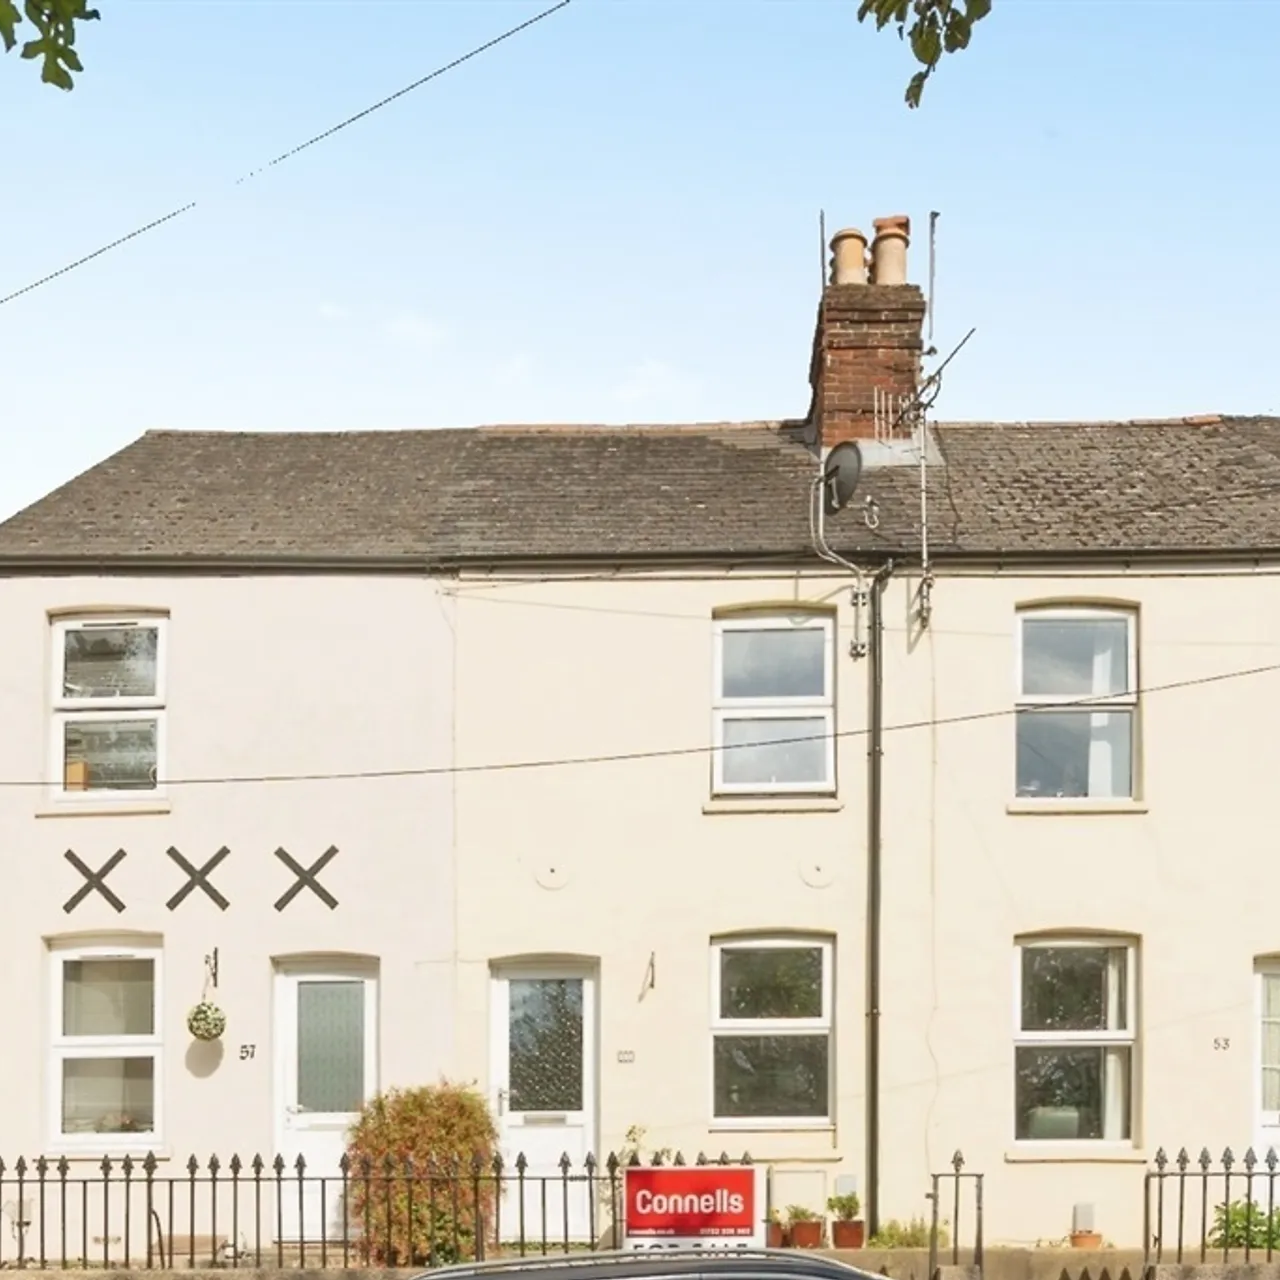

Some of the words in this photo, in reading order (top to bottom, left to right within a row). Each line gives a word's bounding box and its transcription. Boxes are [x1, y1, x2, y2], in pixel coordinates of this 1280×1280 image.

[239, 1044, 256, 1060] 57
[1213, 1037, 1230, 1051] 53
[636, 1189, 744, 1214] Connells
